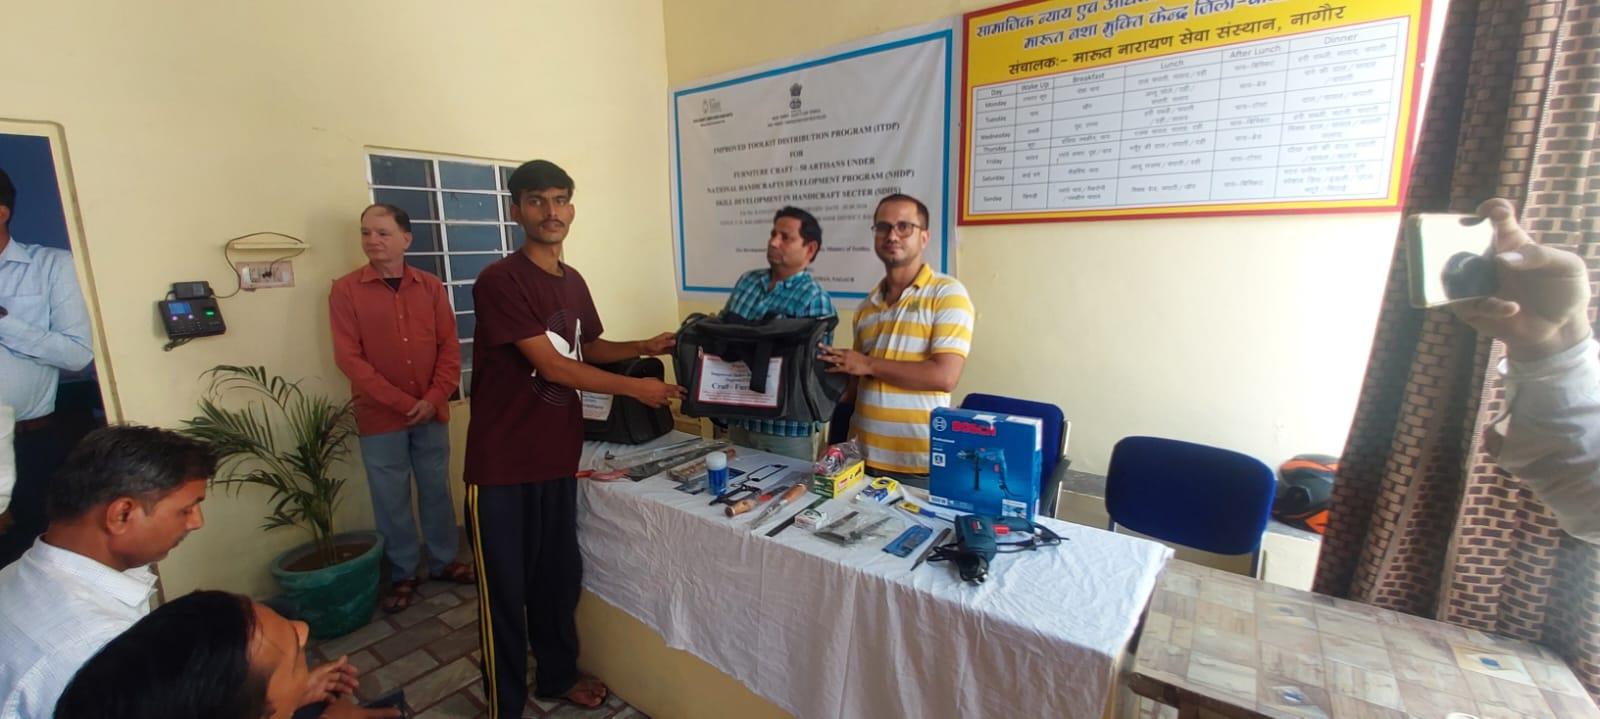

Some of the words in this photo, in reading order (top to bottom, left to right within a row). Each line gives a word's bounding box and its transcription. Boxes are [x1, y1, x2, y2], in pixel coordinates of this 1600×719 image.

[1038, 7, 1073, 25] न्याय
[1068, 23, 1098, 41] नशा
[1103, 14, 1145, 38] मुक्ति
[1117, 35, 1175, 55] नारायण
[1179, 28, 1210, 45] सेवा
[1290, 5, 1346, 26] नागौर
[1323, 33, 1359, 45] Dinner
[1229, 48, 1252, 59] After
[1254, 45, 1281, 56] Lunch
[1160, 59, 1185, 69] Lunch
[1072, 72, 1105, 83] Breakfast
[990, 89, 1003, 97] Day
[713, 144, 746, 154] IMPROVED
[748, 138, 776, 150] TOOLKIT
[778, 132, 829, 145] DISTRIBUTION
[831, 125, 872, 139] PROGRAM
[873, 121, 900, 134] (ITDP)
[789, 150, 804, 158] FOR
[733, 168, 768, 178] FURNITURE
[770, 165, 793, 174] CRAFT
[809, 159, 846, 171] ARTISANS
[847, 157, 876, 167] UNDER
[707, 186, 737, 194] NATIONAL
[785, 176, 840, 187] DEVELOPMENT
[842, 171, 884, 184] PROGRAM
[792, 190, 841, 201] HANDICRAFT
[951, 420, 997, 437] BOSCH
